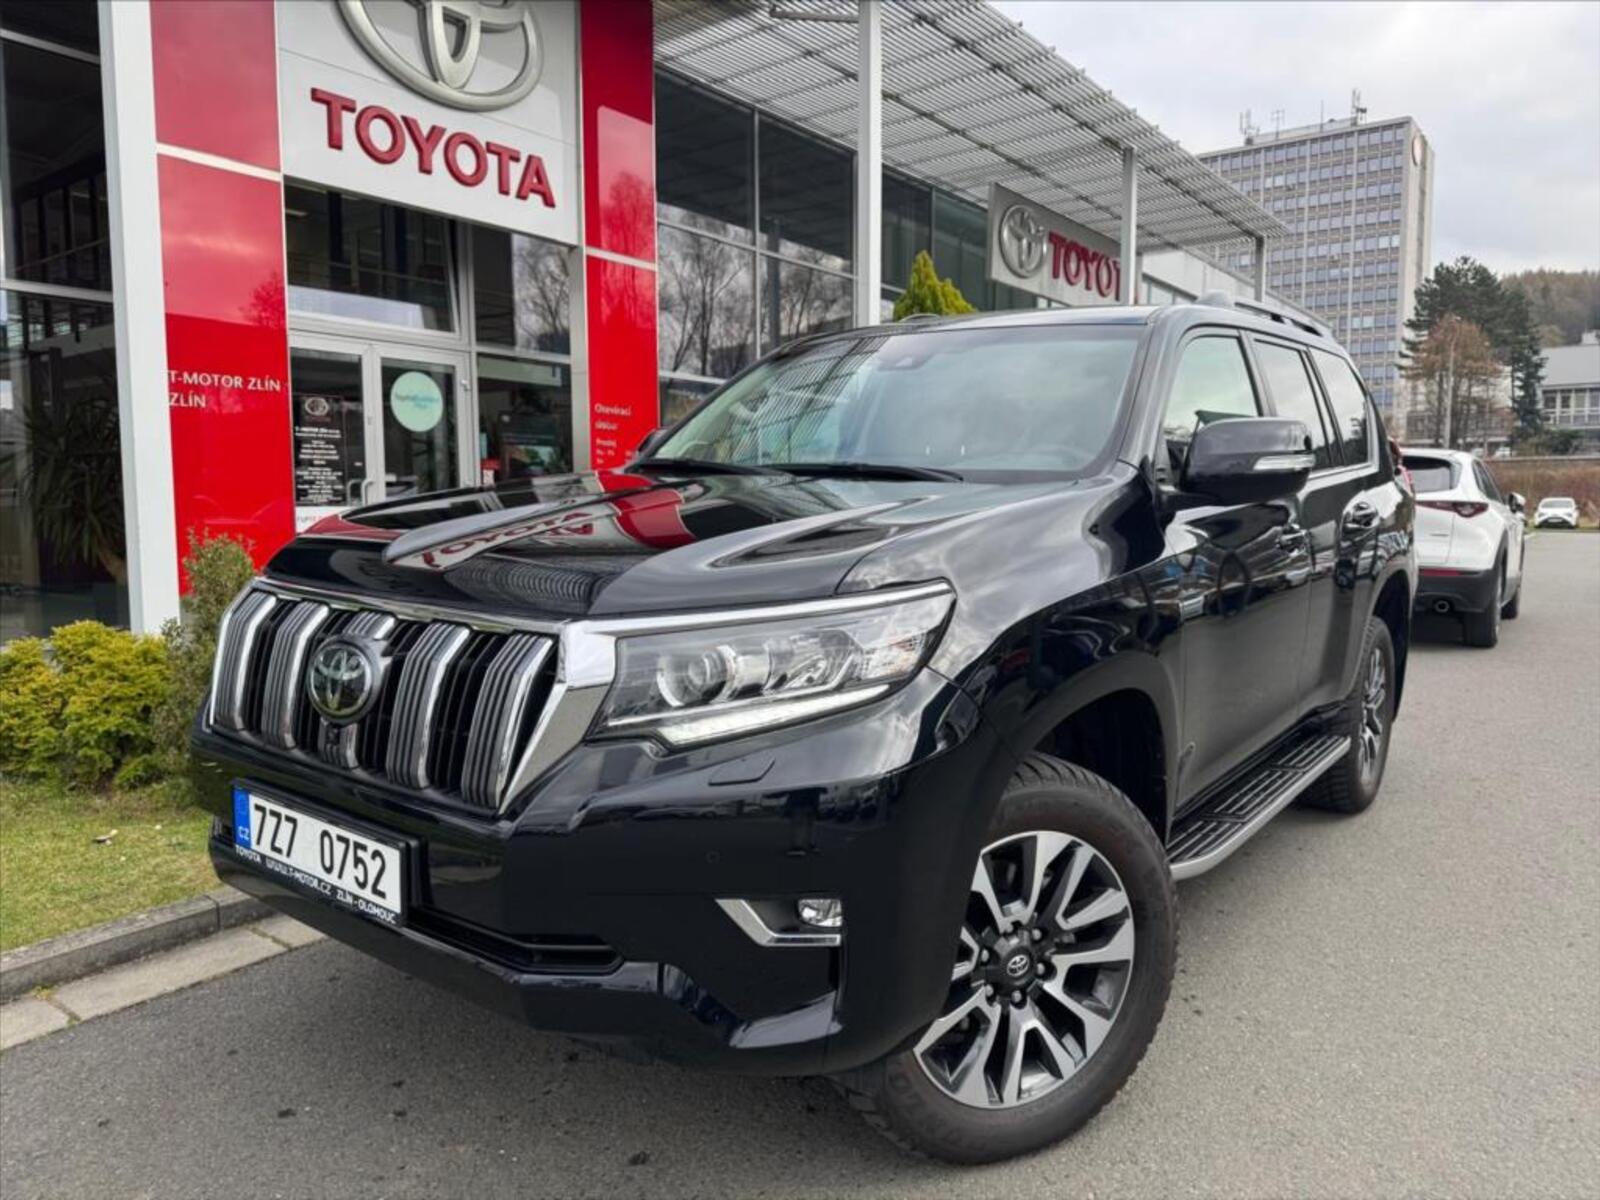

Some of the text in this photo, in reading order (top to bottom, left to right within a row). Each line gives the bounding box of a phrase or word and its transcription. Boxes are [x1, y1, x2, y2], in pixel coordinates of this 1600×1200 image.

[310, 87, 556, 208] TOYOTA
[1048, 230, 1121, 302] TOYOT
[247, 374, 281, 393] ZLÍN
[169, 389, 206, 408] ZLÍN
[238, 826, 250, 840] CZ
[236, 845, 262, 863] TOYOTA
[254, 804, 388, 899] 7Z7 0752
